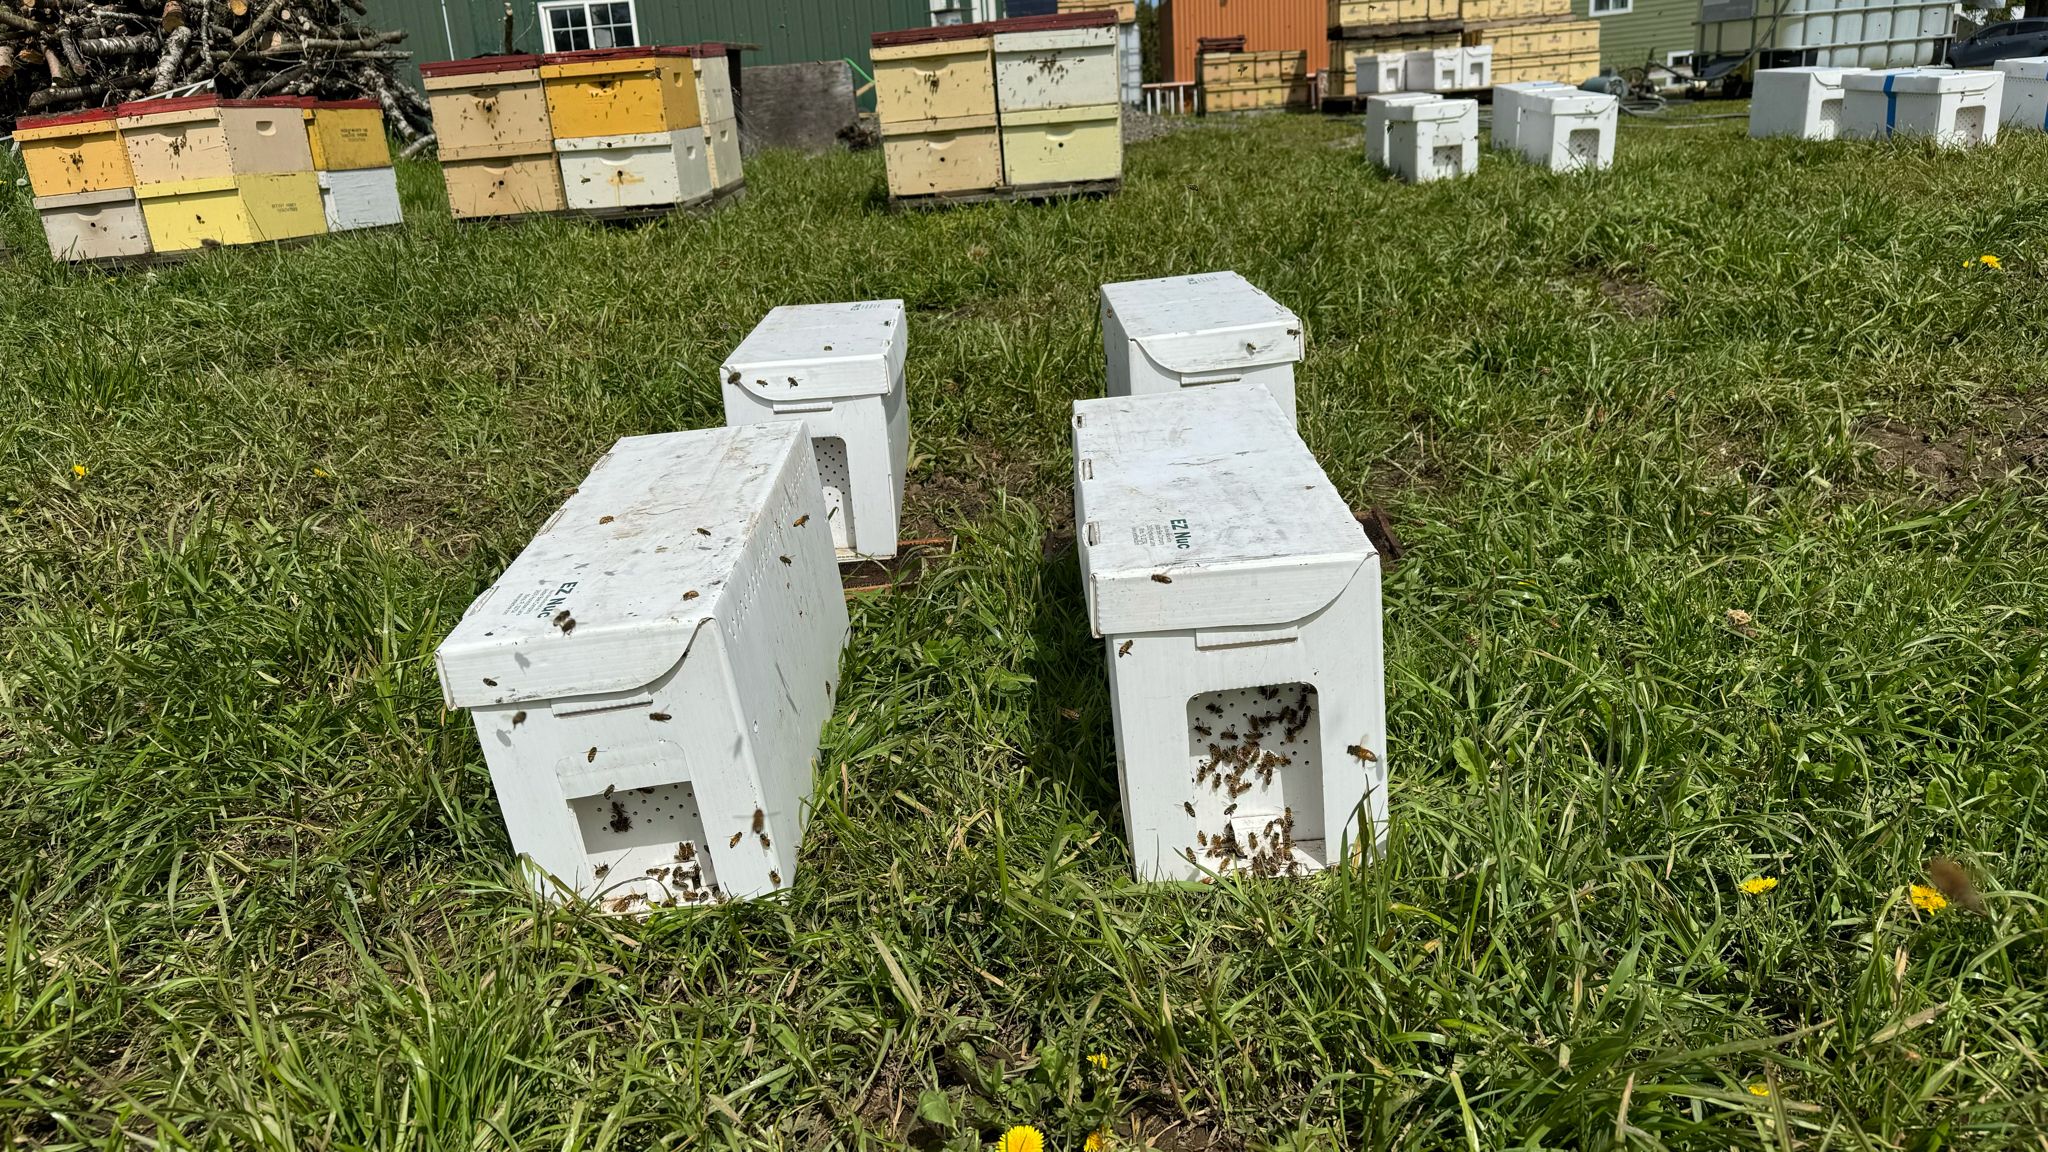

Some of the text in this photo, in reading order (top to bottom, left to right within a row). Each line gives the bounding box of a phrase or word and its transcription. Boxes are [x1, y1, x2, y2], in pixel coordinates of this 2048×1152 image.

[1170, 518, 1191, 549] EZ Nuc
[537, 581, 578, 618] EZ Nuc
